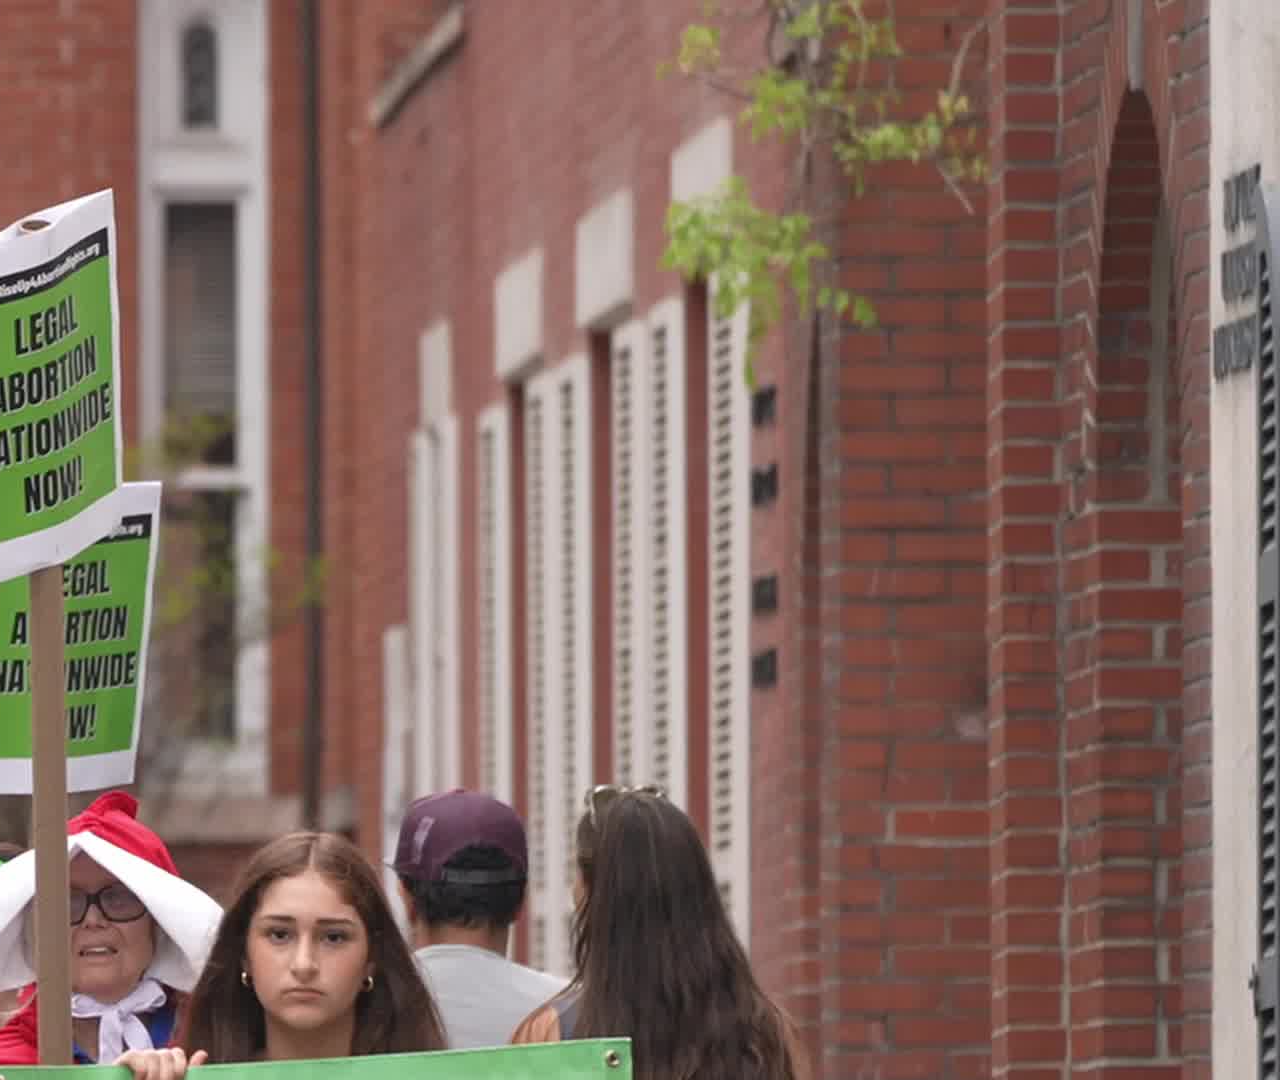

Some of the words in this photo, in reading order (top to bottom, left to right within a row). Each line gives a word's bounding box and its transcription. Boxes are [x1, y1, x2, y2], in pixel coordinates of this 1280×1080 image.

[14, 296, 79, 356] LEGAL
[23, 455, 84, 513] NOW!
[63, 560, 111, 598] EGAL
[9, 604, 128, 646] ARTION
